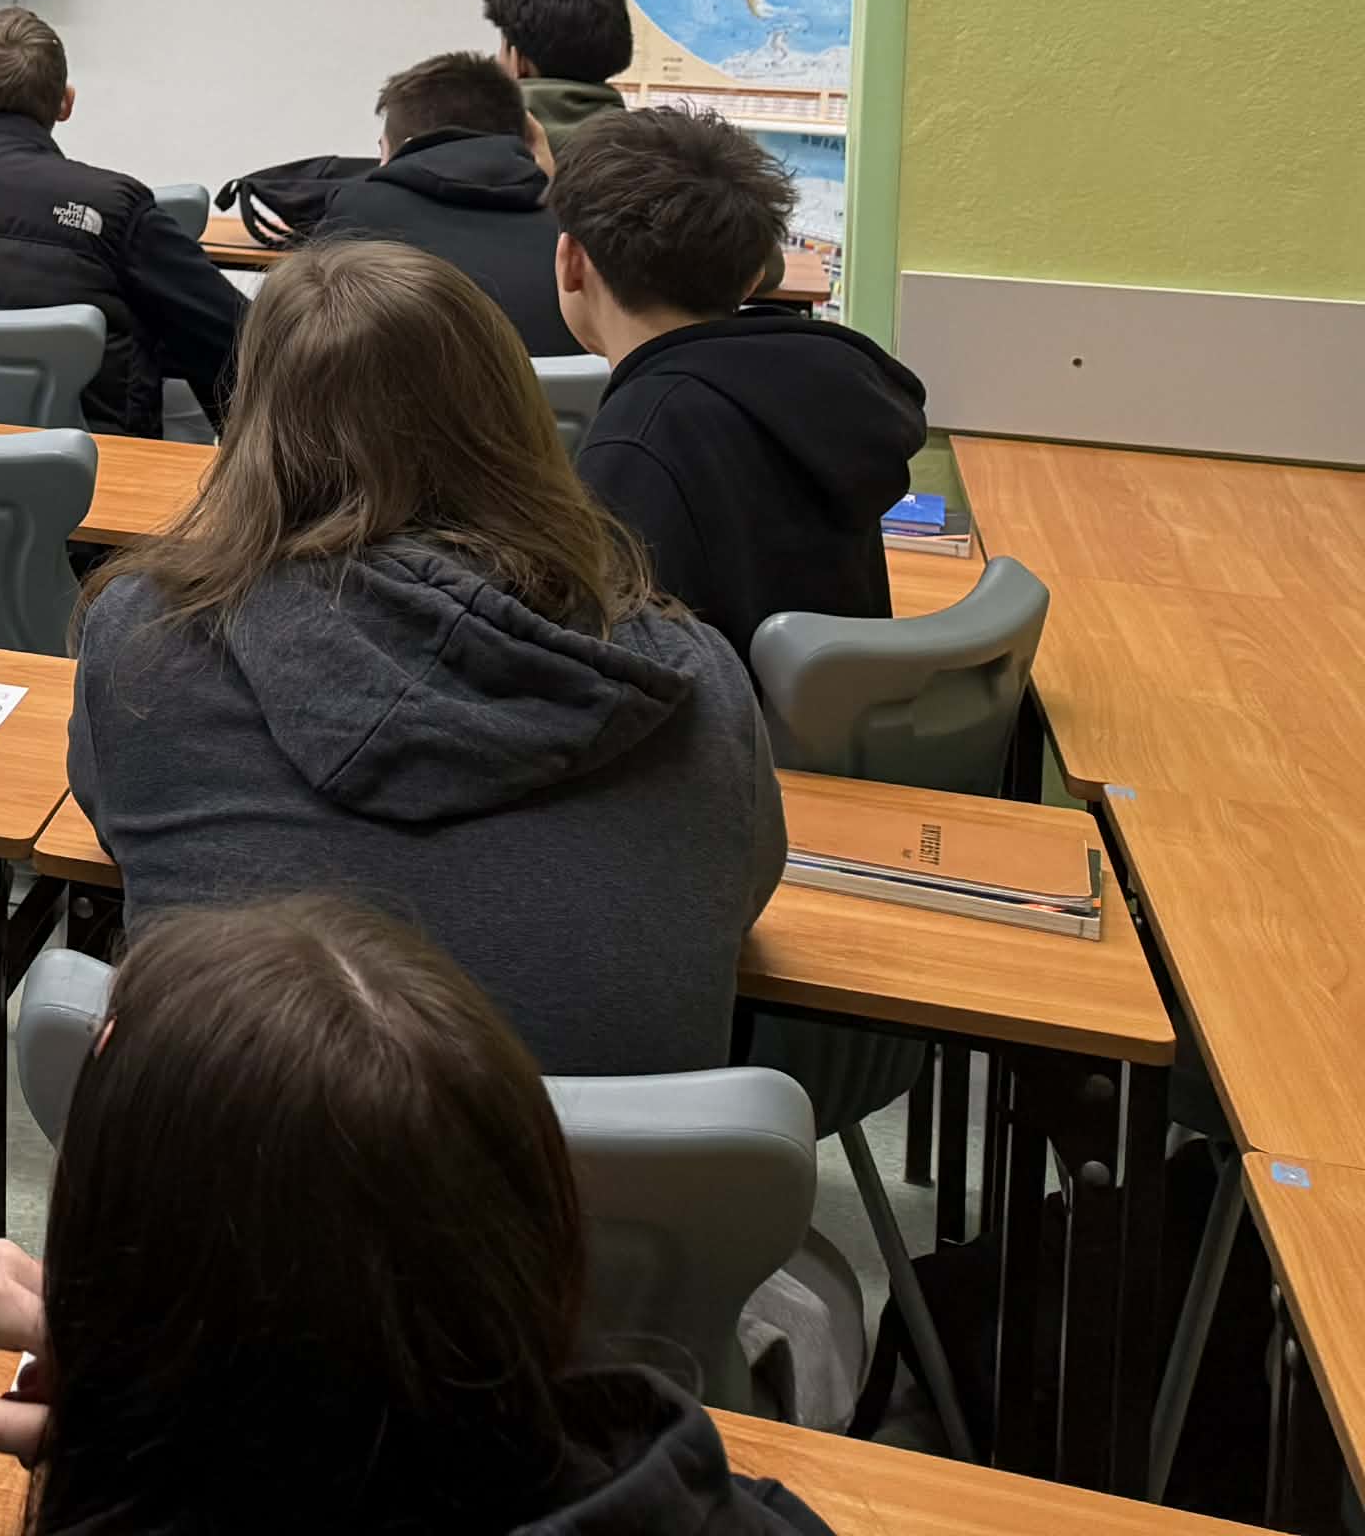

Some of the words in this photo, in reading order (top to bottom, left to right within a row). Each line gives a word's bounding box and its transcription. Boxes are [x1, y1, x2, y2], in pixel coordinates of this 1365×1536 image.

[53, 205, 83, 222] NORTH
[68, 201, 85, 214] THE
[58, 215, 80, 228] FACE
